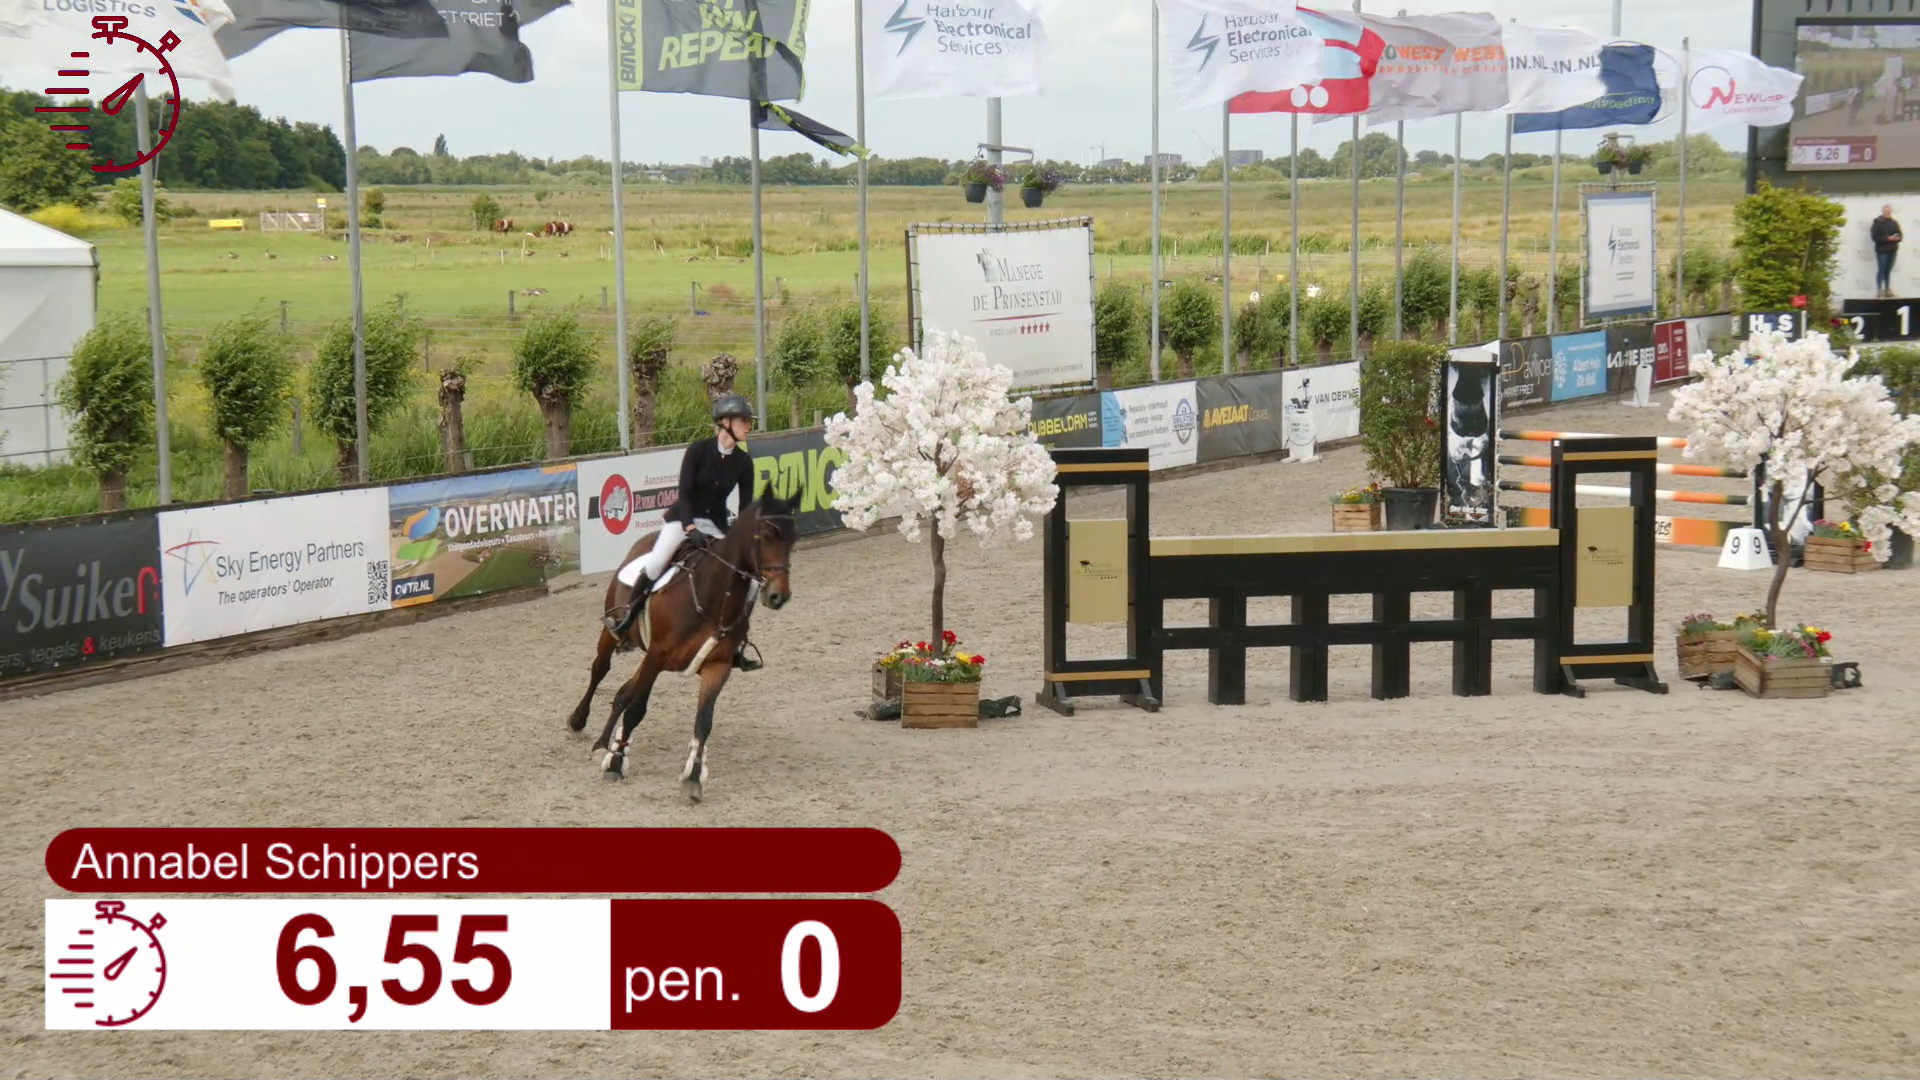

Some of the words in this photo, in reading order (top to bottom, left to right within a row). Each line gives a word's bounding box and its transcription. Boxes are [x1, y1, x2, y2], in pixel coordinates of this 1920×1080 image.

[43, 0, 156, 18] LOGISTICS
[926, 3, 994, 20] Harbour
[933, 18, 1032, 40] Electronical
[658, 30, 778, 71] REPEAT
[937, 35, 1003, 57] Services
[997, 258, 1044, 282] MANEGE
[973, 295, 988, 311] DE
[993, 285, 1063, 310] PRINSENSTAD
[1850, 316, 1865, 340] 2
[1896, 305, 1910, 336] 1
[1314, 392, 1330, 404] VAN
[1332, 390, 1348, 402] DER
[1027, 413, 1088, 437] DUBBELDAM
[1211, 404, 1249, 426] AVEZAAT
[753, 446, 849, 513] BINC
[445, 492, 577, 538] OVERWATER
[1731, 536, 1741, 555] 9
[1753, 536, 1762, 555] 9
[216, 555, 244, 580] Sky
[249, 550, 302, 573] Energy
[306, 541, 364, 564] Partners
[218, 591, 236, 605] The
[293, 577, 334, 595] Operator
[31, 640, 78, 664] tegels
[81, 637, 95, 655] &
[99, 628, 161, 651] keukens
